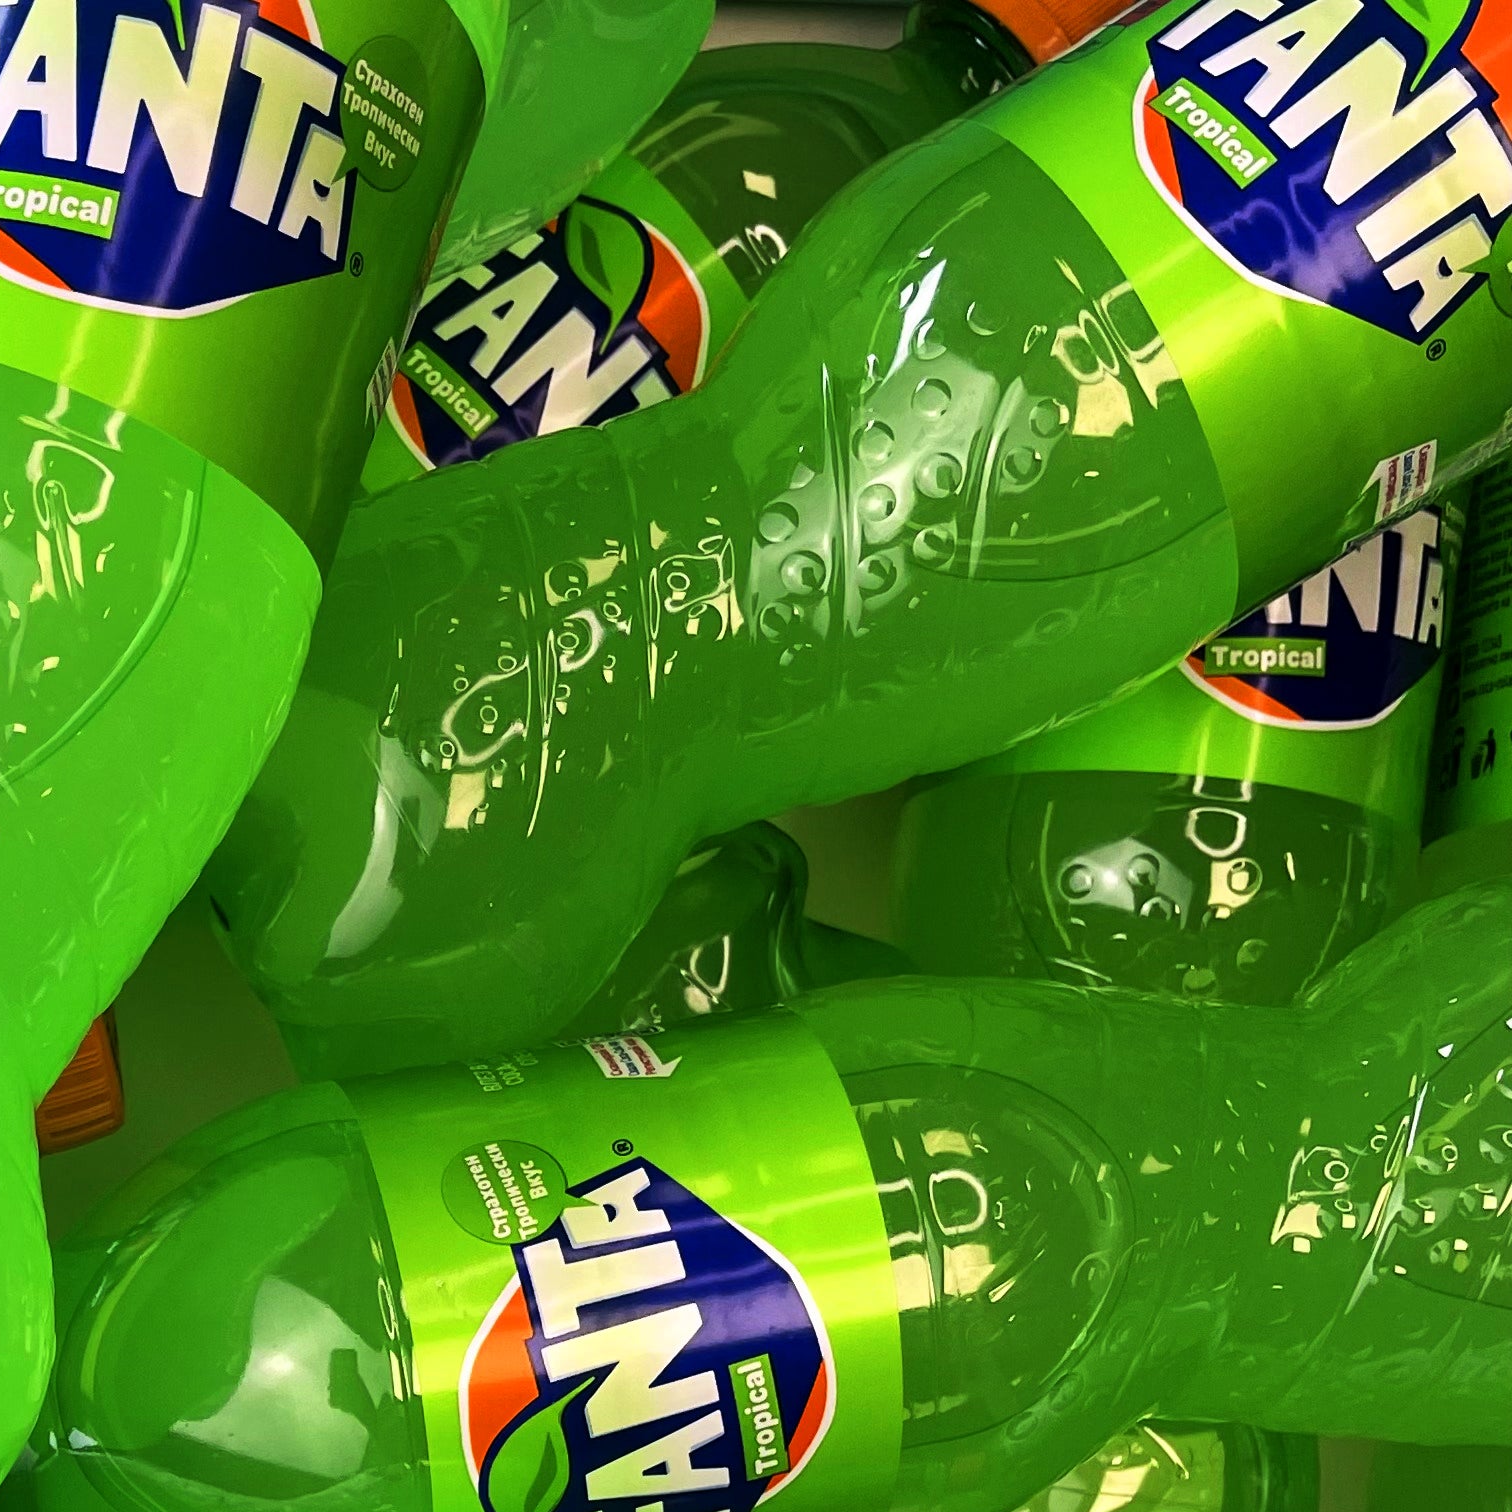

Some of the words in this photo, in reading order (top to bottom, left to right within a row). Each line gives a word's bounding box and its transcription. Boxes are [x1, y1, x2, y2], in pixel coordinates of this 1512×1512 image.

[342, 82, 422, 159] Тропически
[354, 58, 425, 128] Страхотен
[1164, 85, 1268, 179] Tropical
[363, 132, 398, 171] Вкус
[406, 349, 491, 432] Tropical
[1212, 645, 1323, 673] Tropical
[464, 1154, 511, 1239] Страхотен
[484, 1143, 538, 1240] Тропически
[520, 1159, 548, 1200] Вкус
[735, 1360, 780, 1475] Tropical
